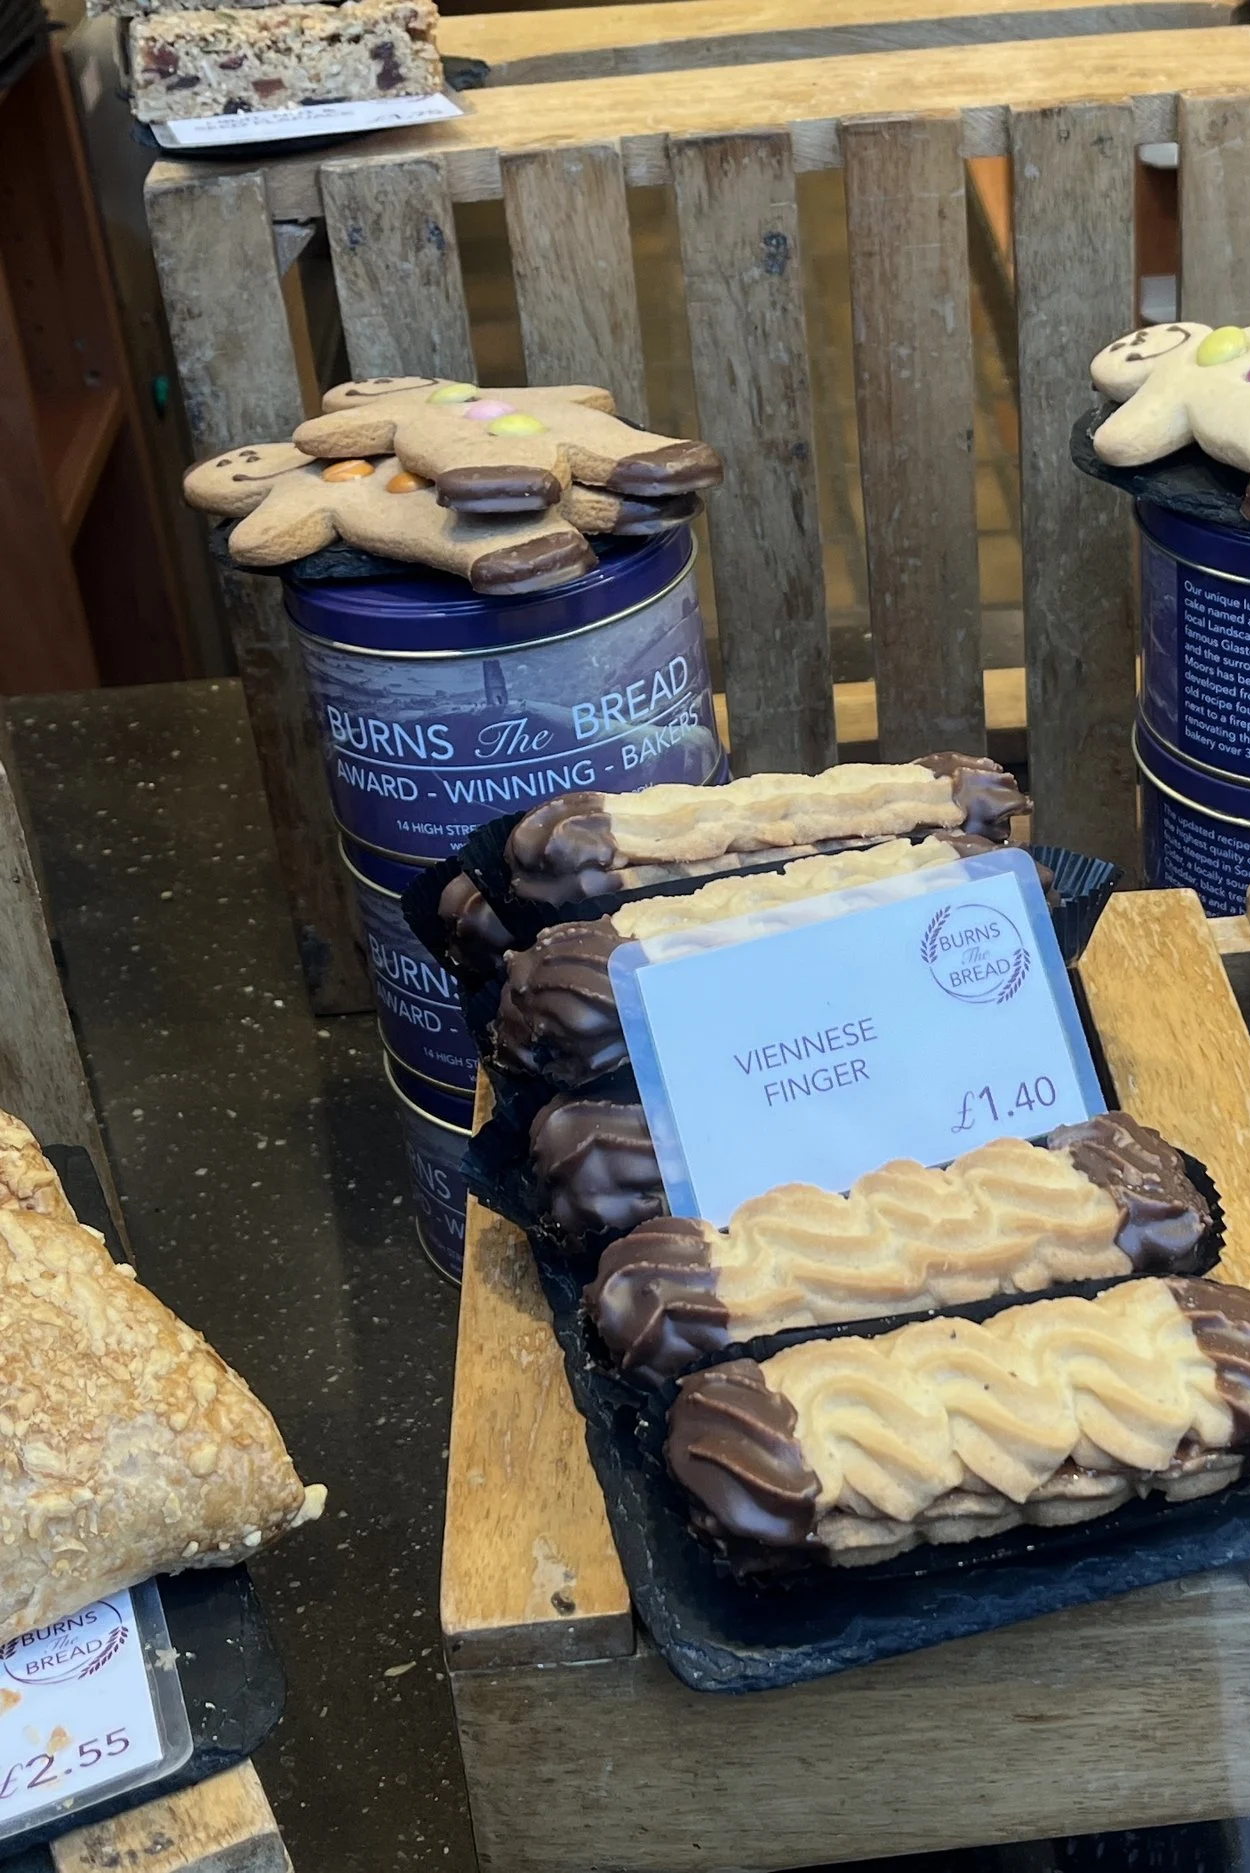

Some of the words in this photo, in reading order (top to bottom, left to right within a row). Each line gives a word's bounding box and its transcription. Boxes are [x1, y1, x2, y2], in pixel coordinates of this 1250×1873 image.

[1184, 581, 1202, 594] Our
[1205, 590, 1240, 608] unique
[1185, 598, 1205, 612] cake
[1208, 607, 1244, 624] named
[1185, 610, 1205, 627] local
[1185, 625, 1219, 647] famous
[1185, 641, 1201, 655] and
[1204, 648, 1220, 662] the
[1185, 654, 1214, 675] Moors
[1217, 668, 1234, 682] has
[1185, 671, 1236, 697] developed
[327, 704, 453, 760] BURNS
[474, 718, 553, 759] The
[572, 655, 689, 741] BREAD
[1185, 686, 1199, 698] old
[1202, 692, 1232, 711] recipe
[1185, 700, 1204, 715] next
[1207, 707, 1217, 719] to
[1220, 715, 1226, 723] a
[1185, 714, 1236, 743] renovating
[1185, 726, 1216, 750] bakery
[1218, 743, 1242, 755] over
[337, 759, 418, 801] AWARD
[443, 760, 595, 804] WINNING
[621, 704, 699, 770] BAKERS
[397, 820, 409, 832] 14
[412, 823, 443, 834] HIGH
[447, 825, 477, 836] STRE
[1178, 815, 1215, 839] updated
[1218, 834, 1250, 850] recipe
[1176, 826, 1208, 849] highest
[1210, 845, 1244, 864] quality
[1183, 845, 1219, 868] steeped
[1222, 862, 1231, 872] in
[1194, 862, 1223, 884] locally
[1226, 878, 1248, 890] sour
[1200, 880, 1225, 896] black
[1208, 899, 1227, 911] and
[938, 922, 1001, 952] BURNS
[961, 946, 991, 965] The
[948, 958, 1011, 988] BREAD
[377, 980, 441, 1032] AWARD
[424, 1047, 433, 1058] 14
[436, 1052, 462, 1067] HIGH
[734, 1017, 878, 1076] VIENNESE
[763, 1059, 870, 1107] FINGER
[950, 1076, 1057, 1133] £1.40
[22, 1610, 98, 1647] BURNS
[26, 1638, 103, 1676] BREAD
[50, 1635, 79, 1651] The
[0, 1728, 130, 1799] £2.55
